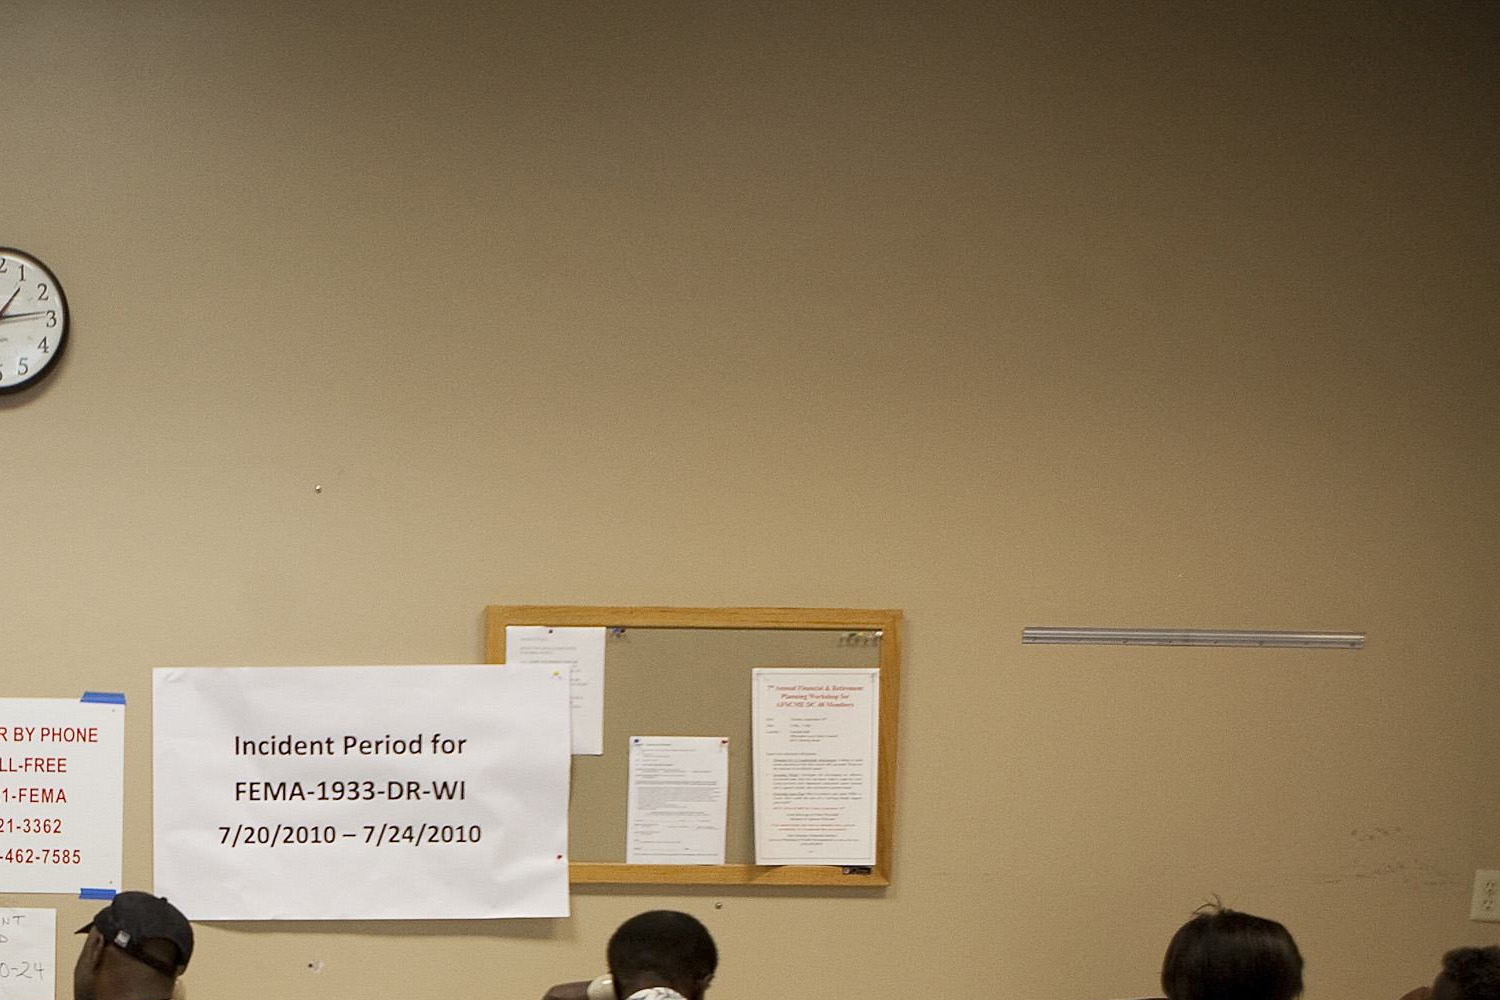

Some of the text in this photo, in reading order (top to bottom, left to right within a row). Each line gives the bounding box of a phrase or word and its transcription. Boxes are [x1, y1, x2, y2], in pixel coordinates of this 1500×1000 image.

[19, 264, 26, 281] 1
[37, 284, 48, 300] 2
[46, 310, 57, 328] 3
[38, 336, 49, 353] 4
[18, 358, 28, 375] 5
[13, 727, 35, 742] BY
[41, 727, 98, 743] PHONE
[235, 733, 467, 756] Incident Period for
[235, 781, 466, 801] FEMA-1933-DR-WI
[218, 824, 336, 848] 7/20/2010
[363, 823, 481, 847] 7/24/2010
